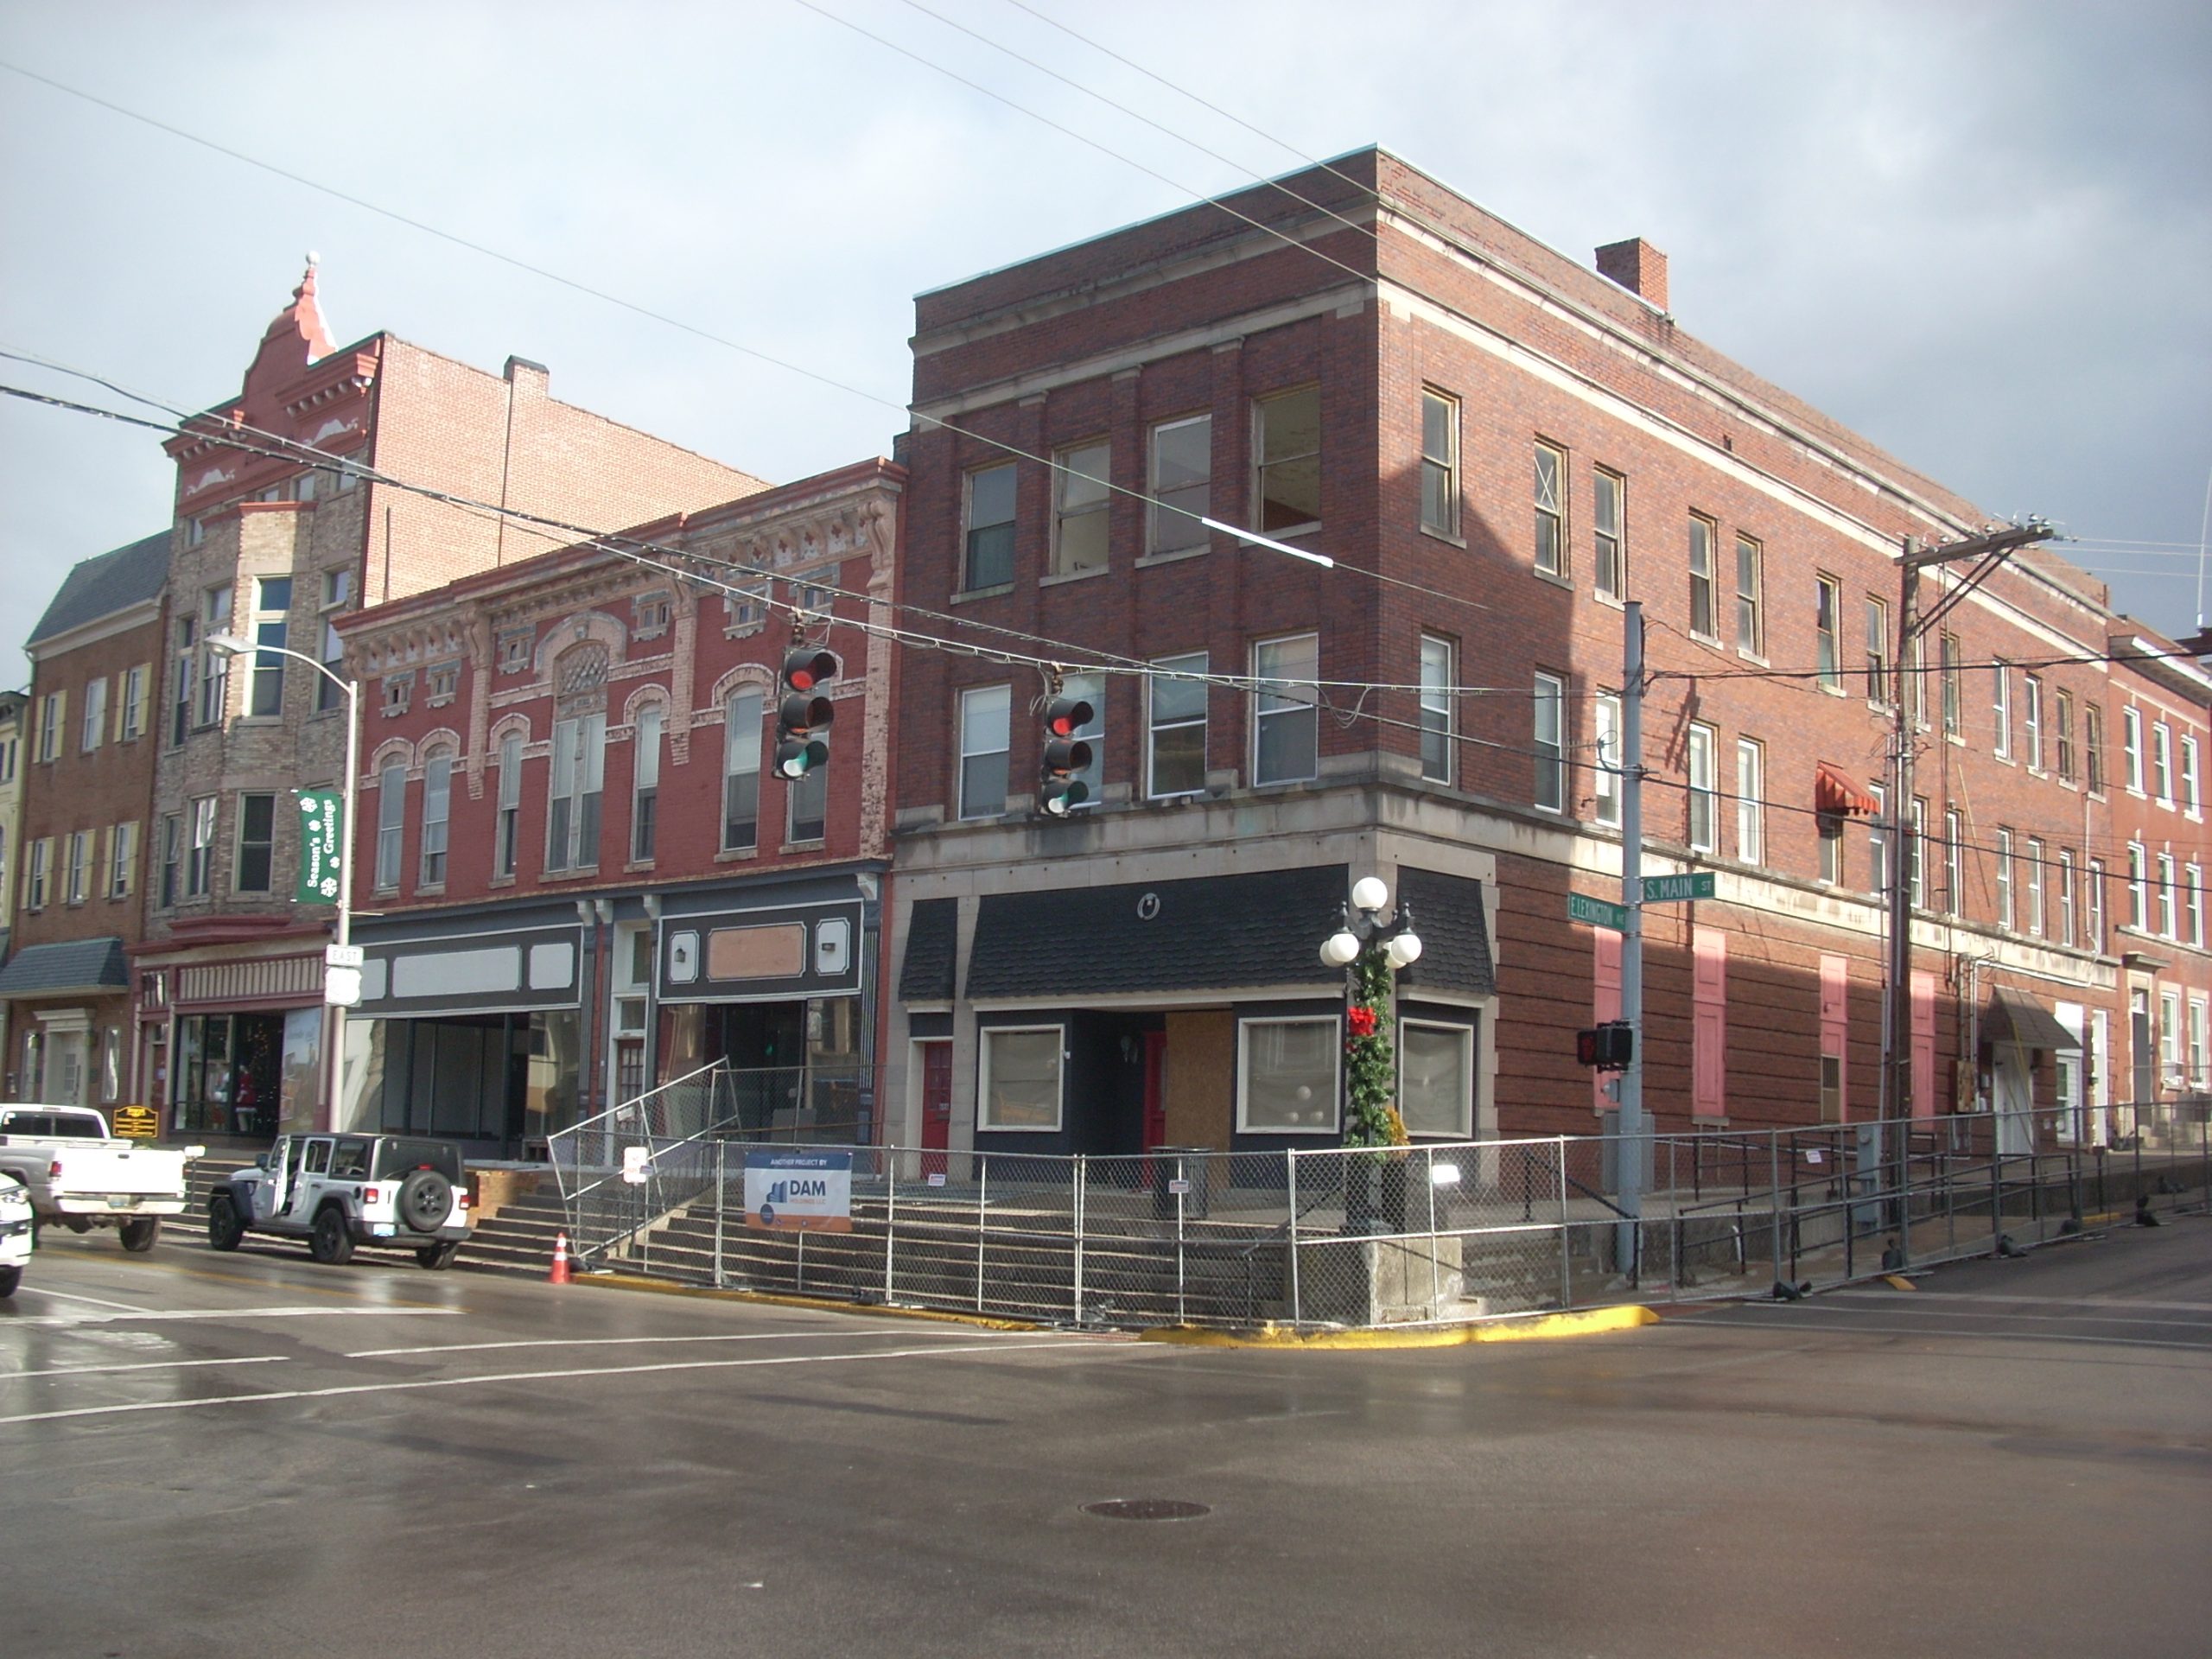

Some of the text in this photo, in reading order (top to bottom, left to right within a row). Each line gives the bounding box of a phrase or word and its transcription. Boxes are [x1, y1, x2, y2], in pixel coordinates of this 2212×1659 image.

[323, 799, 336, 854] Greetings
[307, 837, 321, 887] Season's
[1647, 878, 1712, 899] S. MAIN ST
[1578, 898, 1613, 926] LEXINGTON
[332, 950, 357, 962] EAST
[790, 1180, 826, 1197] DAM
